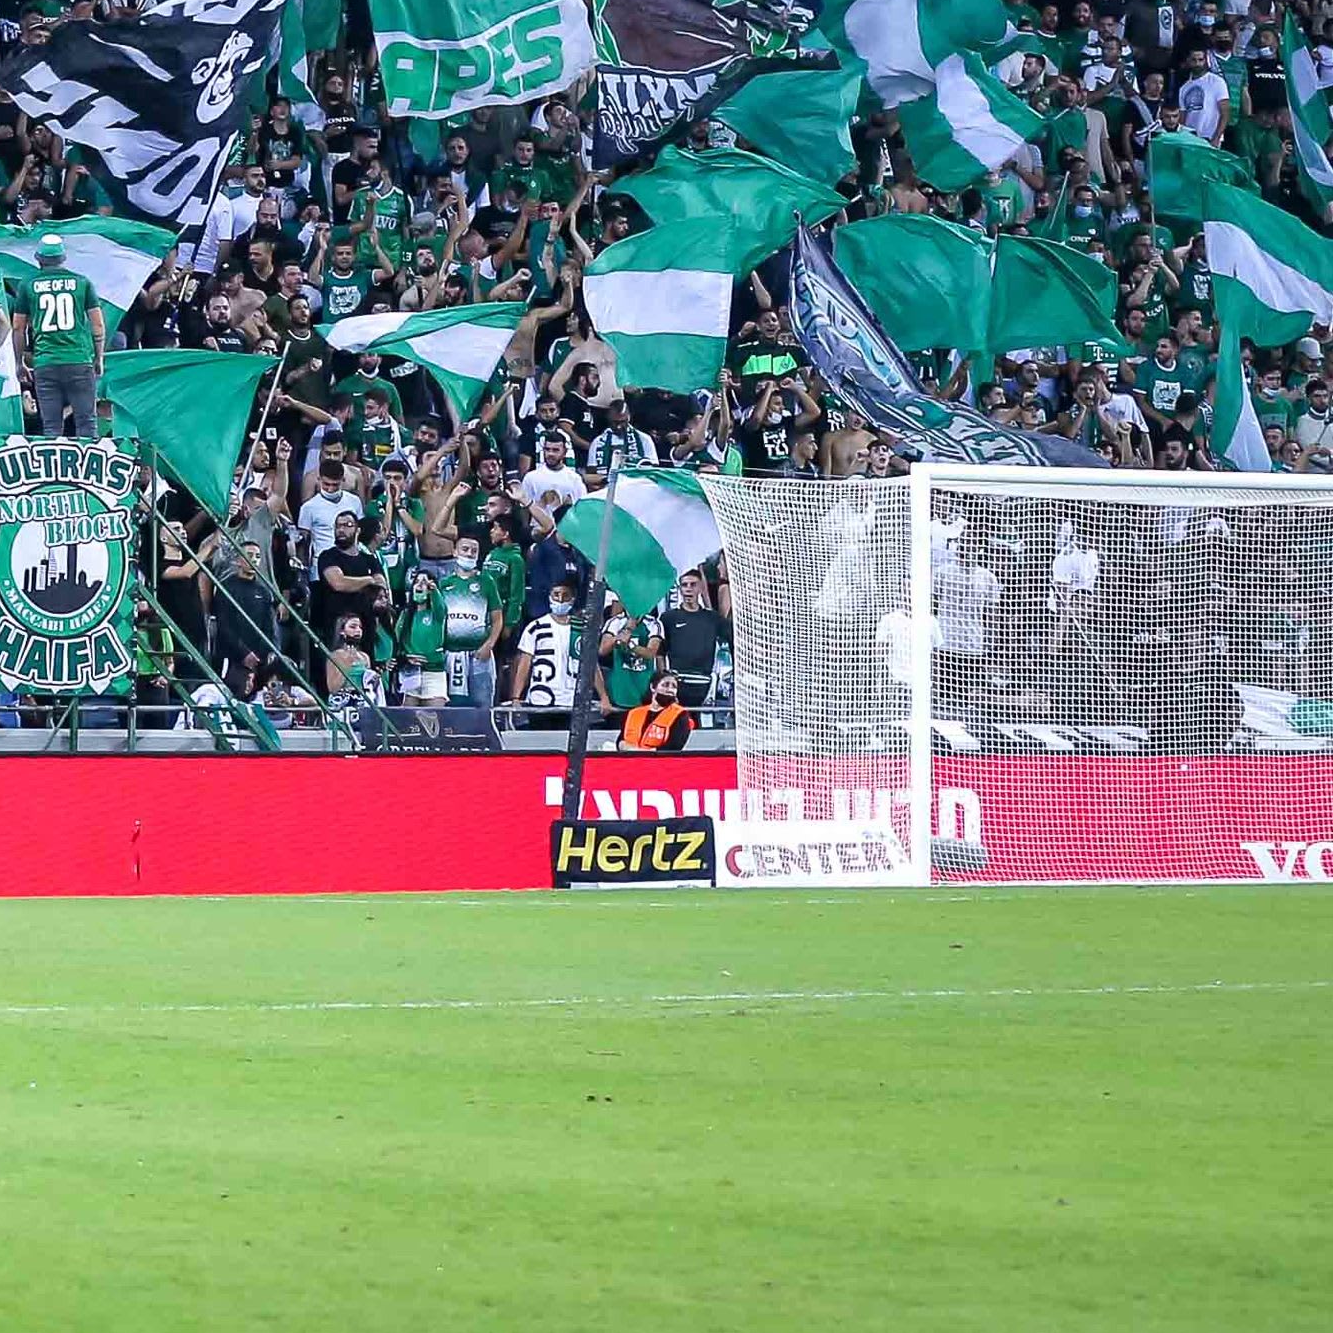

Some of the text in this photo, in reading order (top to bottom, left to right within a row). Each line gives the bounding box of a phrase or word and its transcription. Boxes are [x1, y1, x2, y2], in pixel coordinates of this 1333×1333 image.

[377, 4, 566, 113] APES
[1254, 71, 1286, 80] VOLVO
[327, 115, 356, 126] ONDA
[33, 280, 52, 293] ONE
[39, 292, 75, 334] 20
[45, 512, 128, 546] BLOCK
[4, 587, 112, 633] MACCABI HAIFA
[556, 826, 707, 873] Hertz
